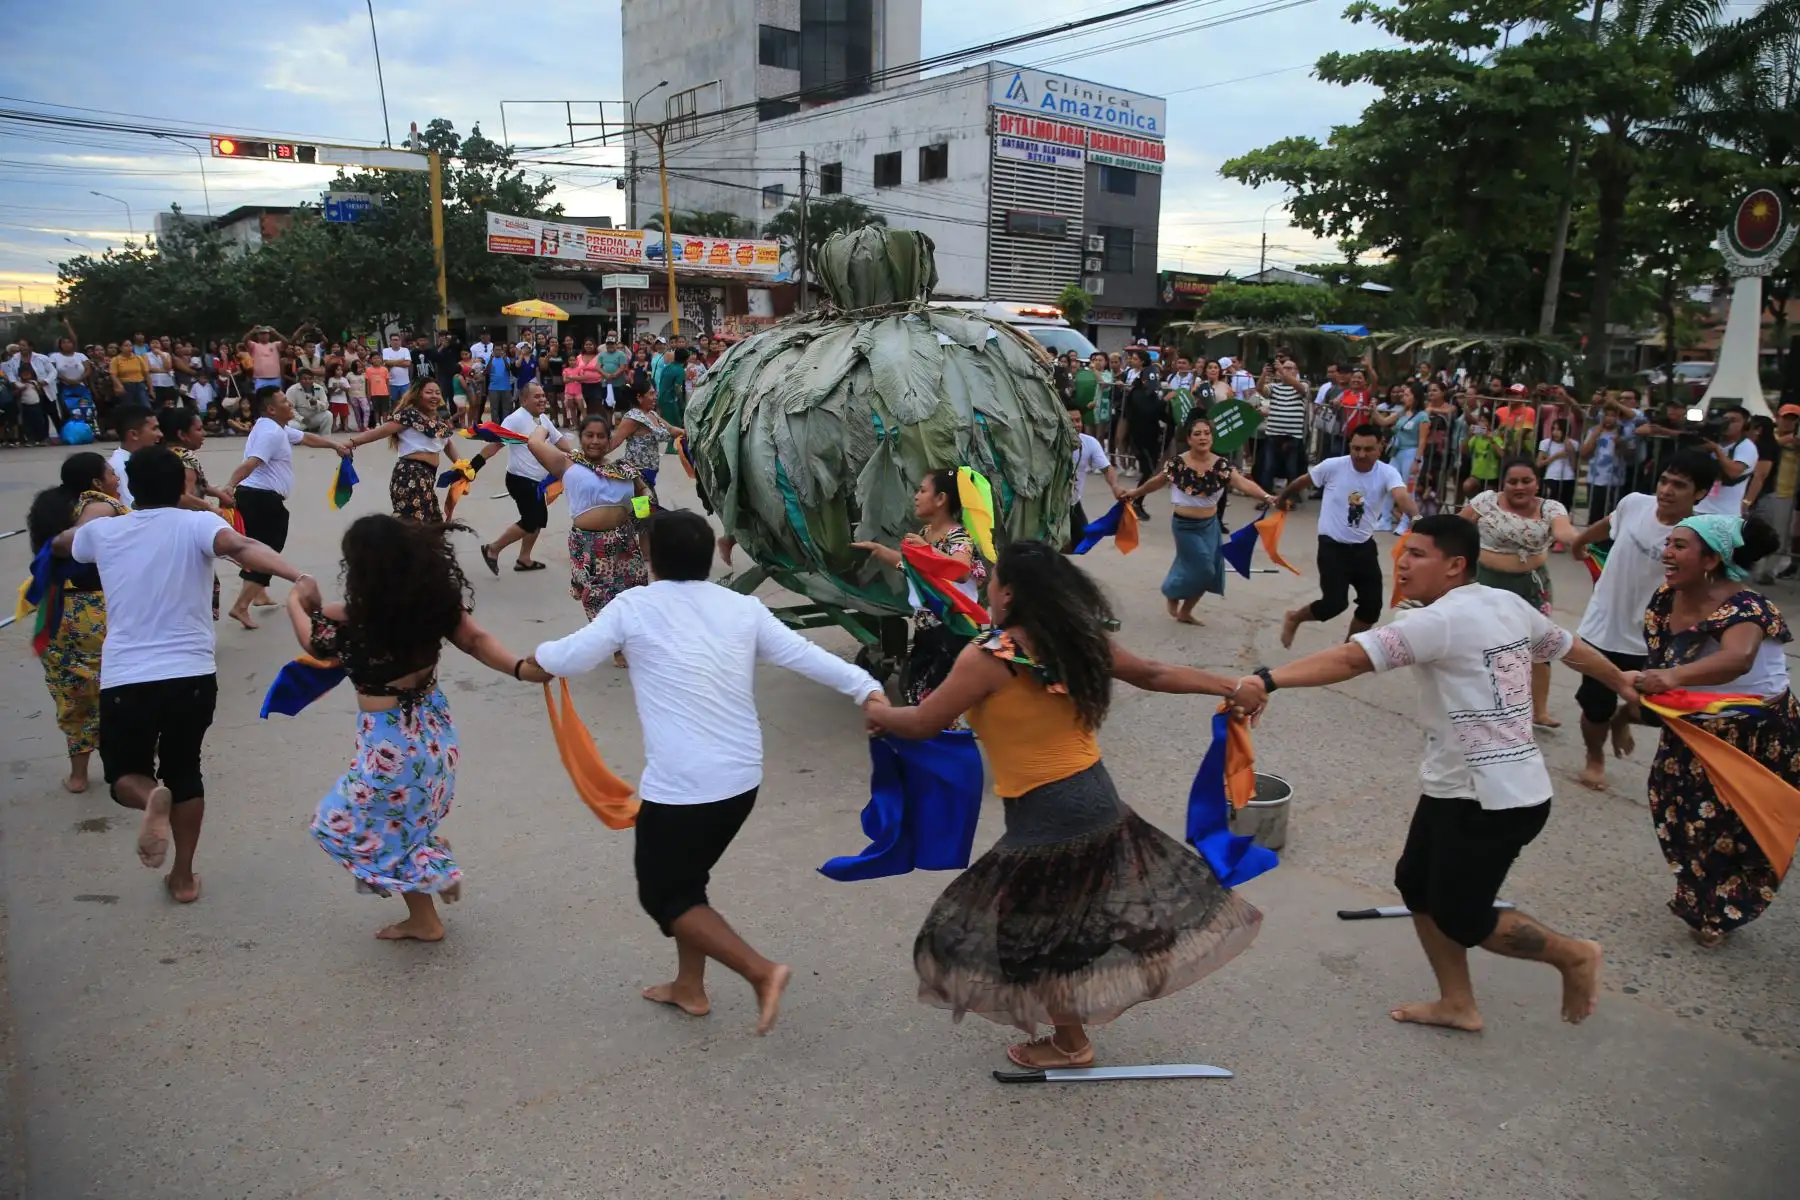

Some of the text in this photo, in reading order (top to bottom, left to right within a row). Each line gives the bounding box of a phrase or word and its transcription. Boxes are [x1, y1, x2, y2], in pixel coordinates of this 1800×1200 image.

[278, 145, 290, 157] 33
[586, 235, 642, 248] PREDIAL Y
[586, 244, 642, 258] VEHICULAR
